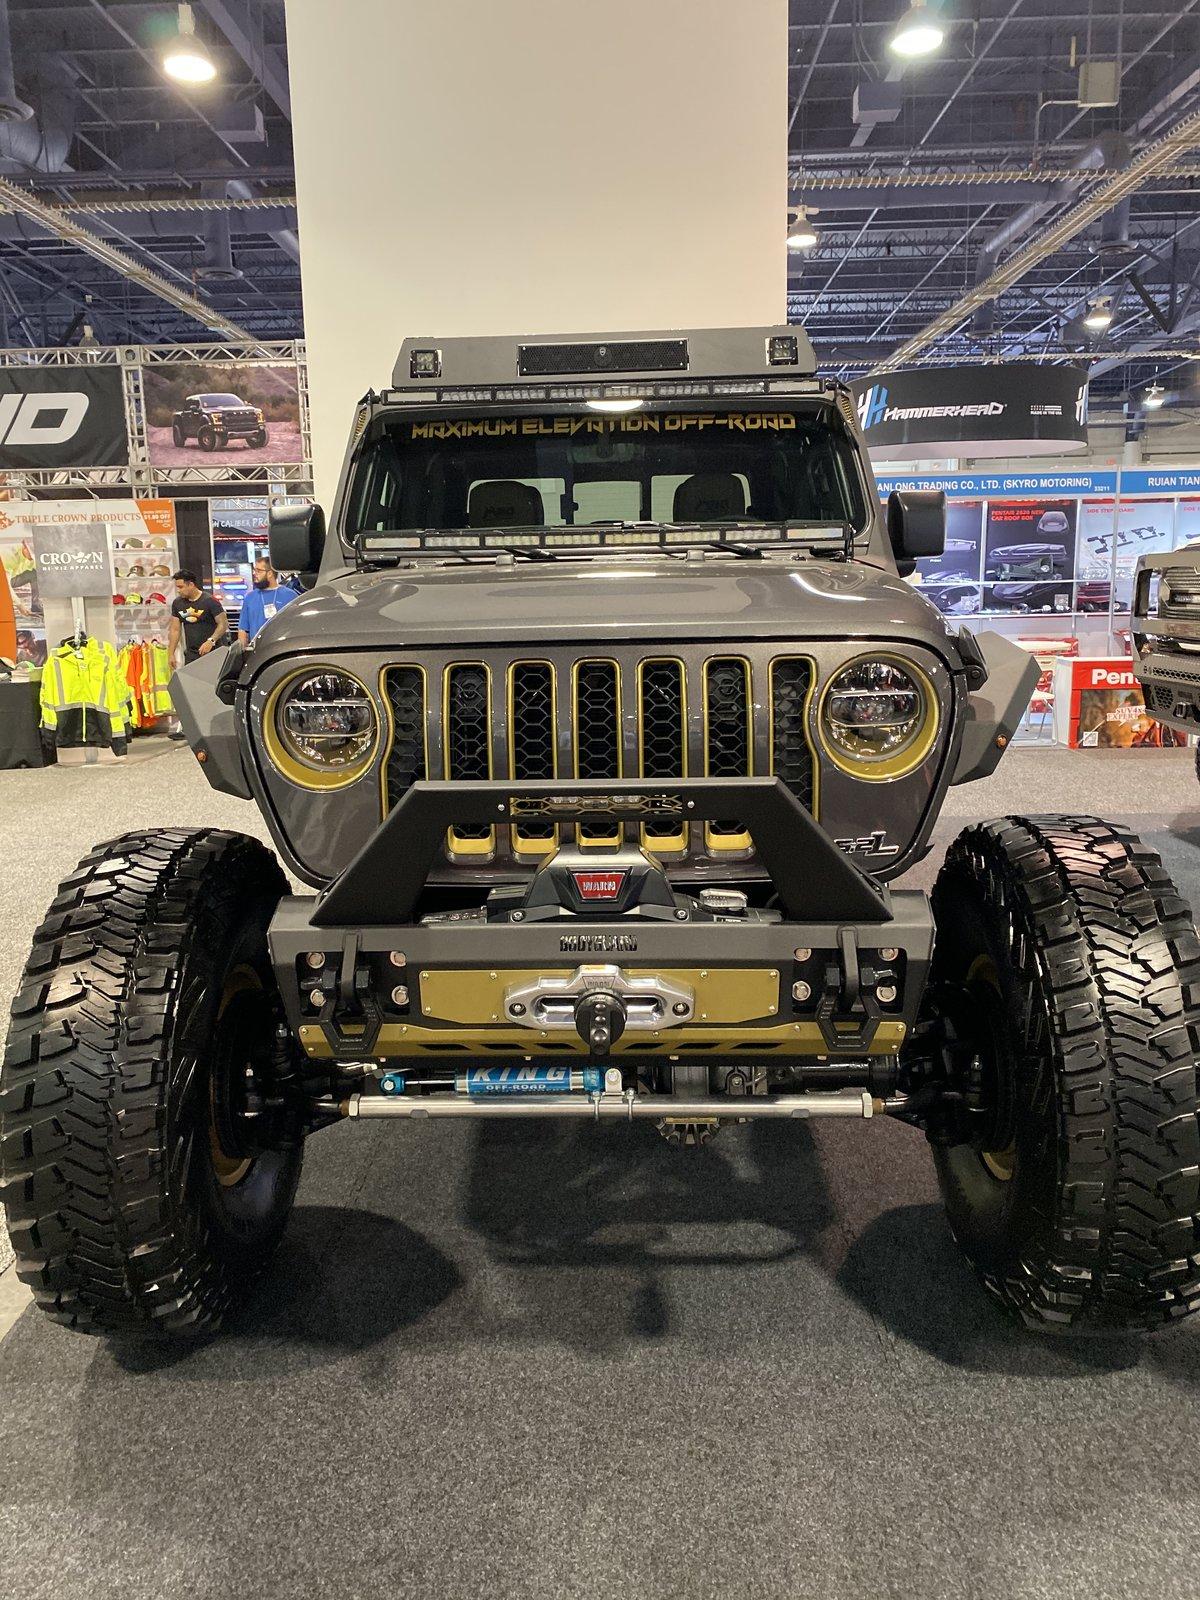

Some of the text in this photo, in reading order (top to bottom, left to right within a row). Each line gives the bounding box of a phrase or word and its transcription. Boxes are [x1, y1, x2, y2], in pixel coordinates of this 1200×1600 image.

[884, 402, 1004, 422] HAMMERHEAD
[411, 413, 796, 439] MAXIMUM ELEVATION OFF-ROAD
[918, 481, 957, 491] TRADING
[960, 480, 979, 490] CO.,
[981, 480, 1000, 489] LTD.
[1003, 479, 1037, 491] (SKYRO
[1040, 477, 1092, 489] MOTORING)
[1148, 477, 1176, 487] RUIAN
[15, 514, 50, 524] TRIPLE
[52, 513, 87, 523] CROWN
[91, 512, 141, 523] PRODUCTS
[40, 551, 104, 565] CROWN
[583, 881, 616, 891] WARN
[559, 935, 638, 952] BODYGUARD
[472, 1066, 567, 1083] KING
[486, 1083, 546, 1091] OFF-ROAD
